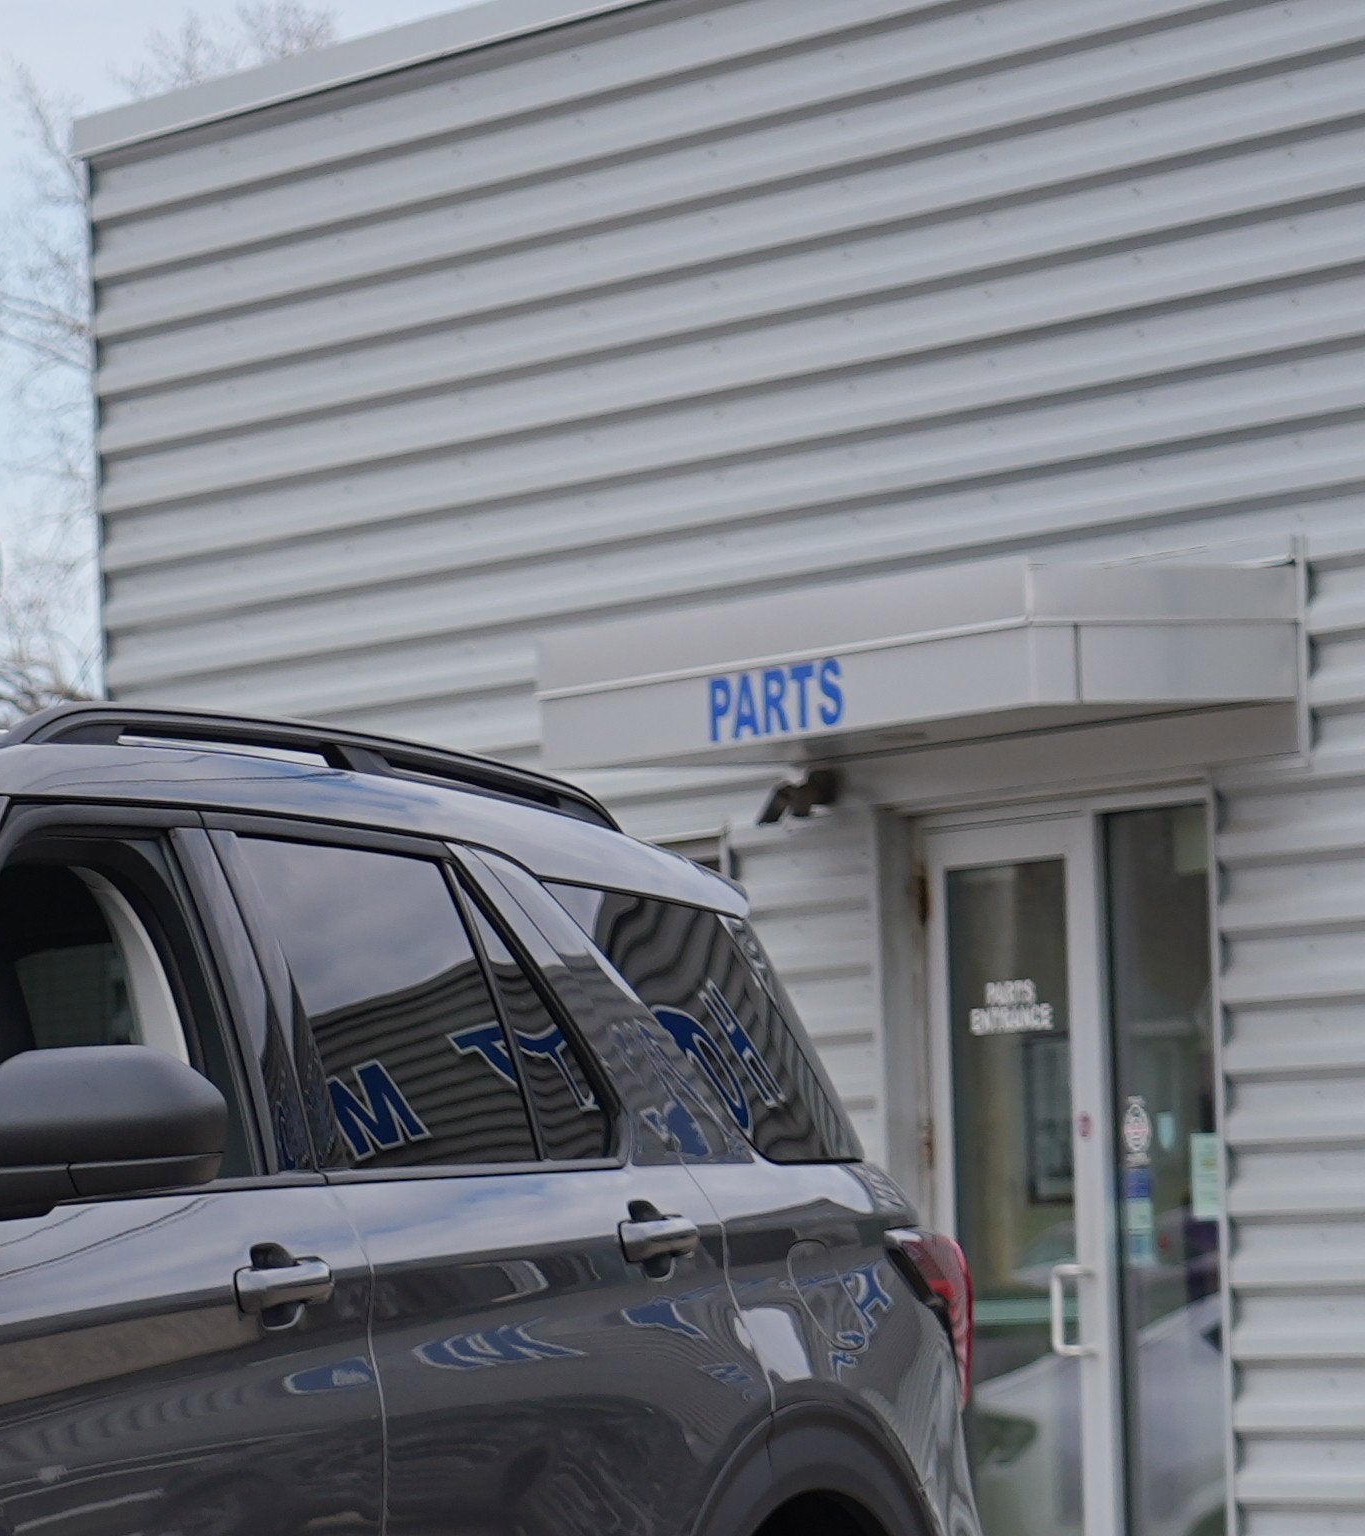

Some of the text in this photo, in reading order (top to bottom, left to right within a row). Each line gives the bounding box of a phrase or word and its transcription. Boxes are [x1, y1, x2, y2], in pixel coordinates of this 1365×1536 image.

[708, 656, 845, 742] PARTS
[984, 978, 1037, 1006] PARTS
[970, 1002, 1055, 1036] ENTRANCE
